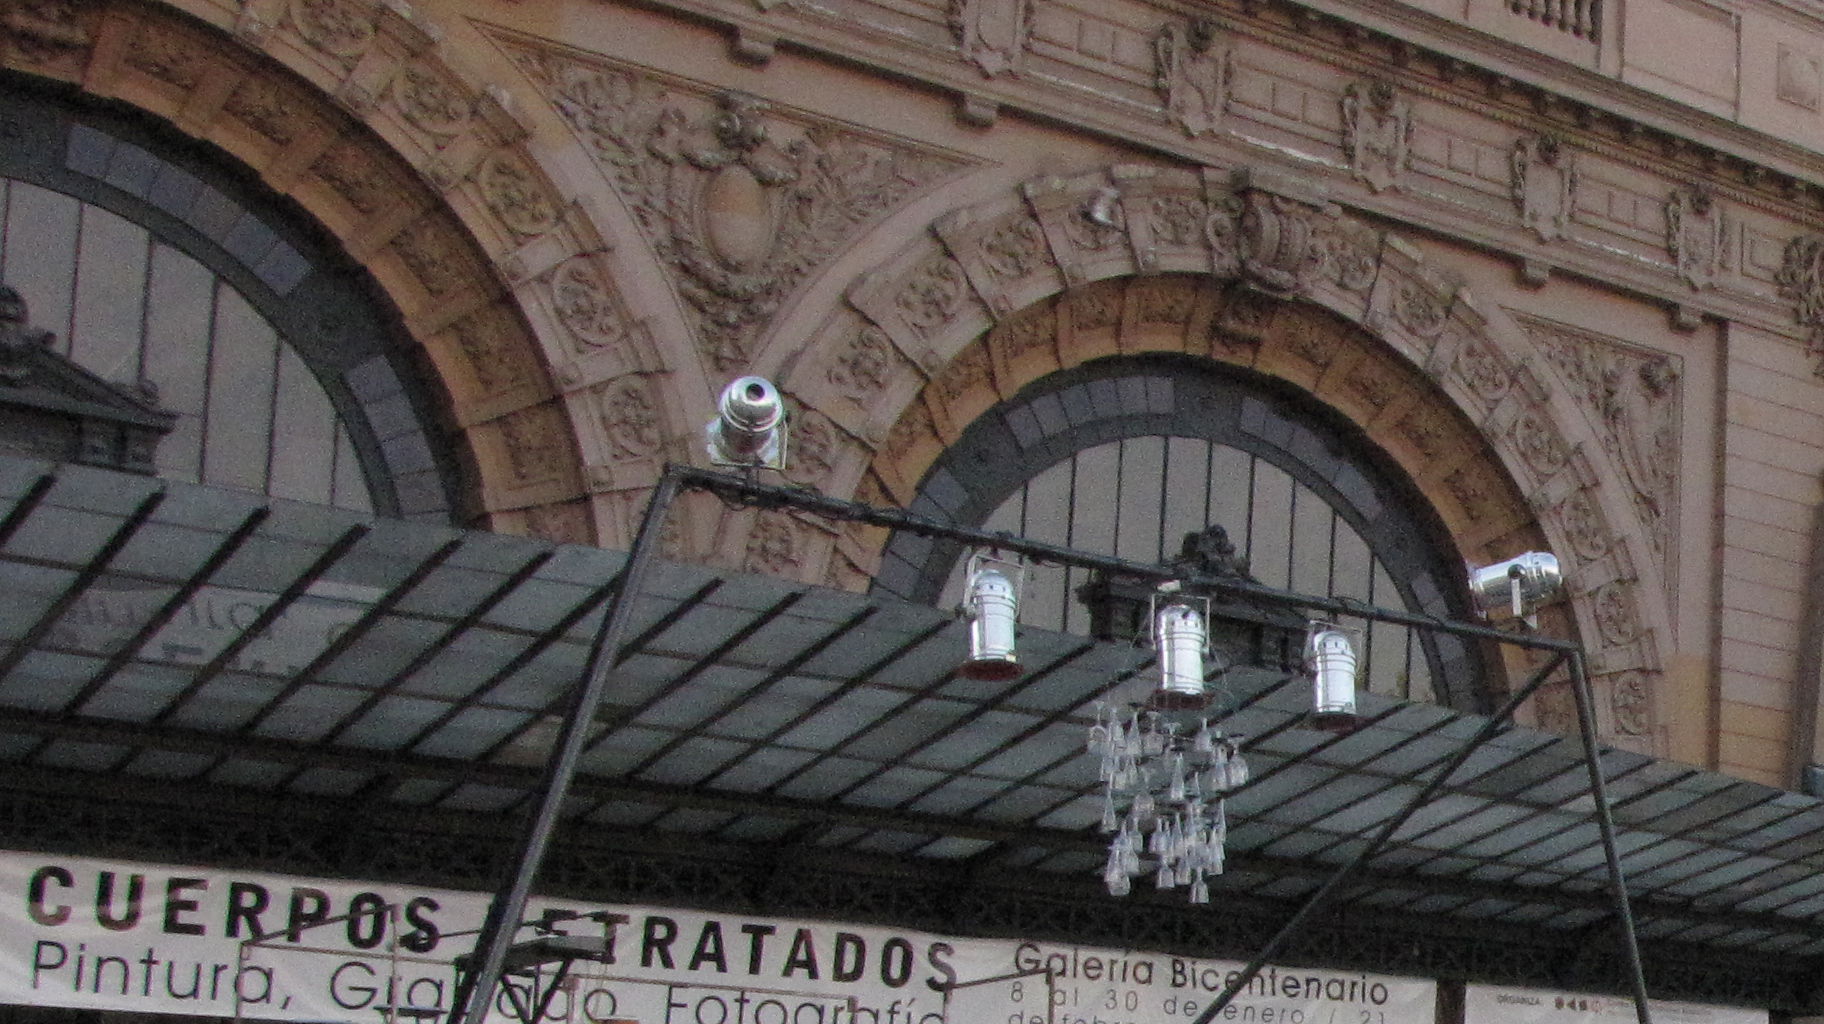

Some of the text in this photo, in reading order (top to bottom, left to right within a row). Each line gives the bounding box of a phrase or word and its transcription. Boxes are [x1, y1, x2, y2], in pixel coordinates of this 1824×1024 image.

[27, 865, 441, 953] CUERPOS
[32, 939, 293, 1010] Pintura,
[1010, 980, 1024, 1003] 8
[1053, 987, 1079, 1007] al
[1104, 988, 1139, 1012] 30
[1162, 995, 1198, 1017] de
[1014, 942, 1389, 1006] Galería Bicentenario
